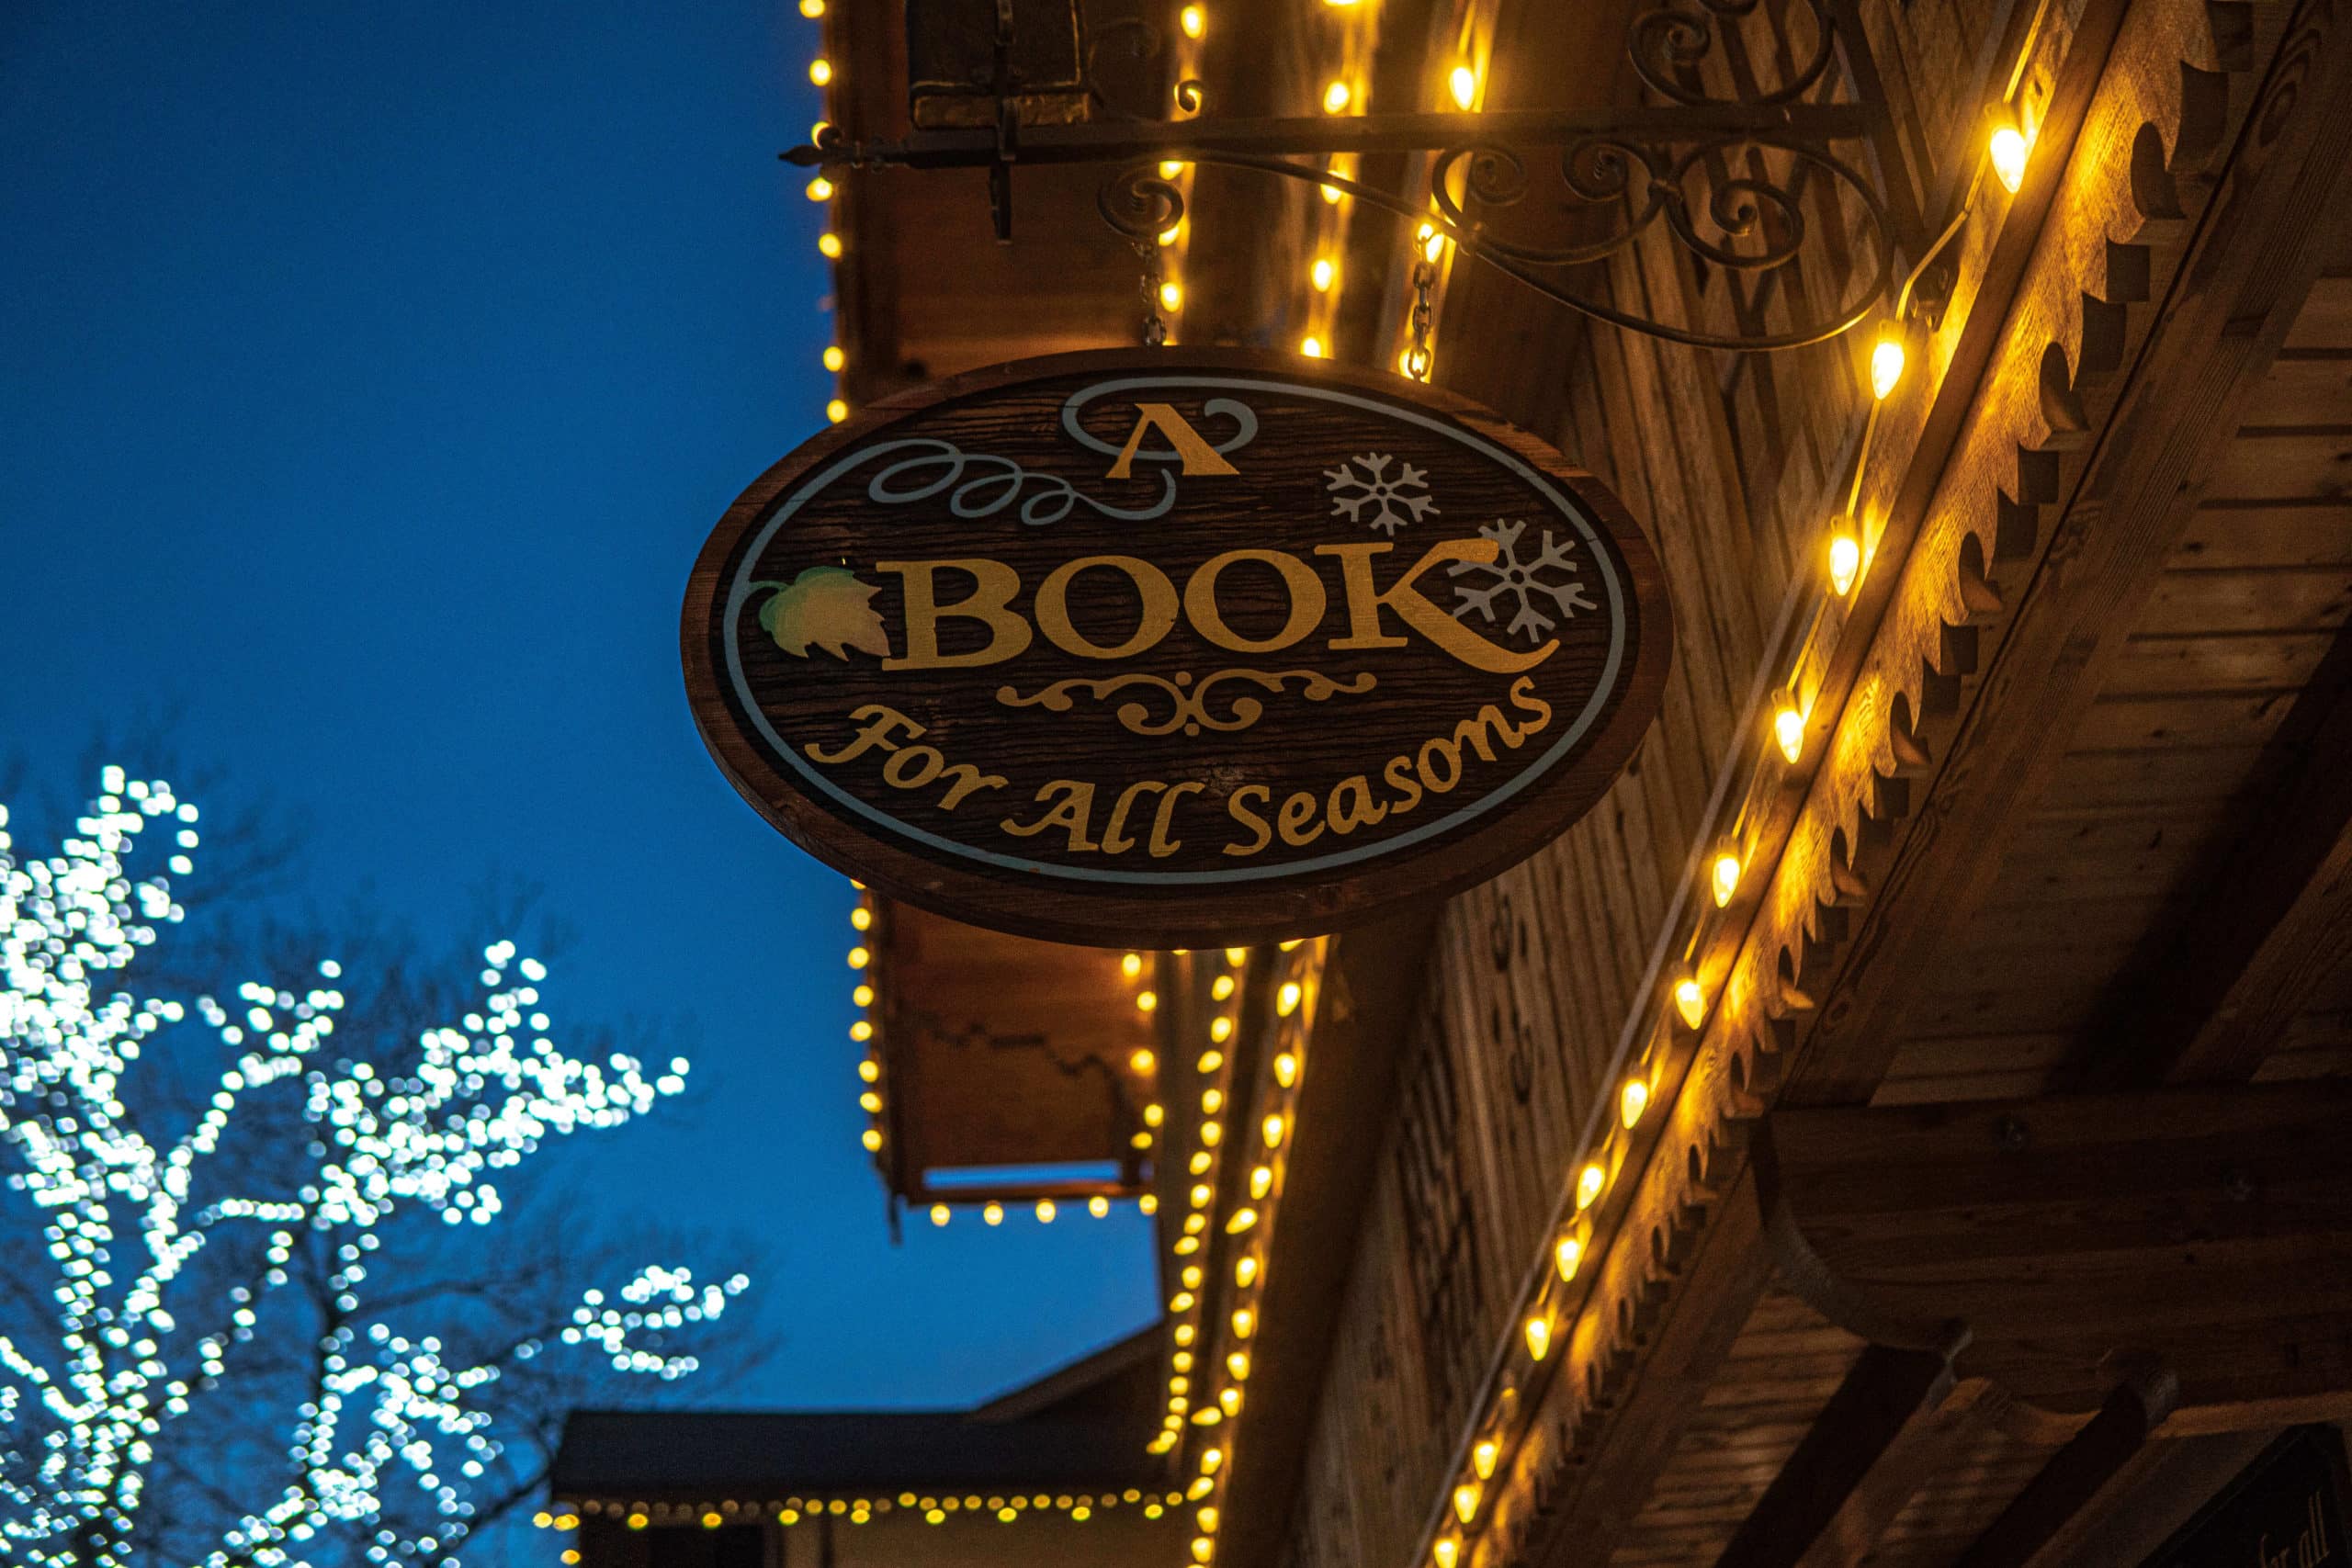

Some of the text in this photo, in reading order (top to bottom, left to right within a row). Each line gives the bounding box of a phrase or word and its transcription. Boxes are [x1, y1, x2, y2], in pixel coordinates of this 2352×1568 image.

[1105, 402, 1241, 479] A
[874, 537, 1562, 673] BOOK
[803, 675, 1555, 858] For All Seasons
